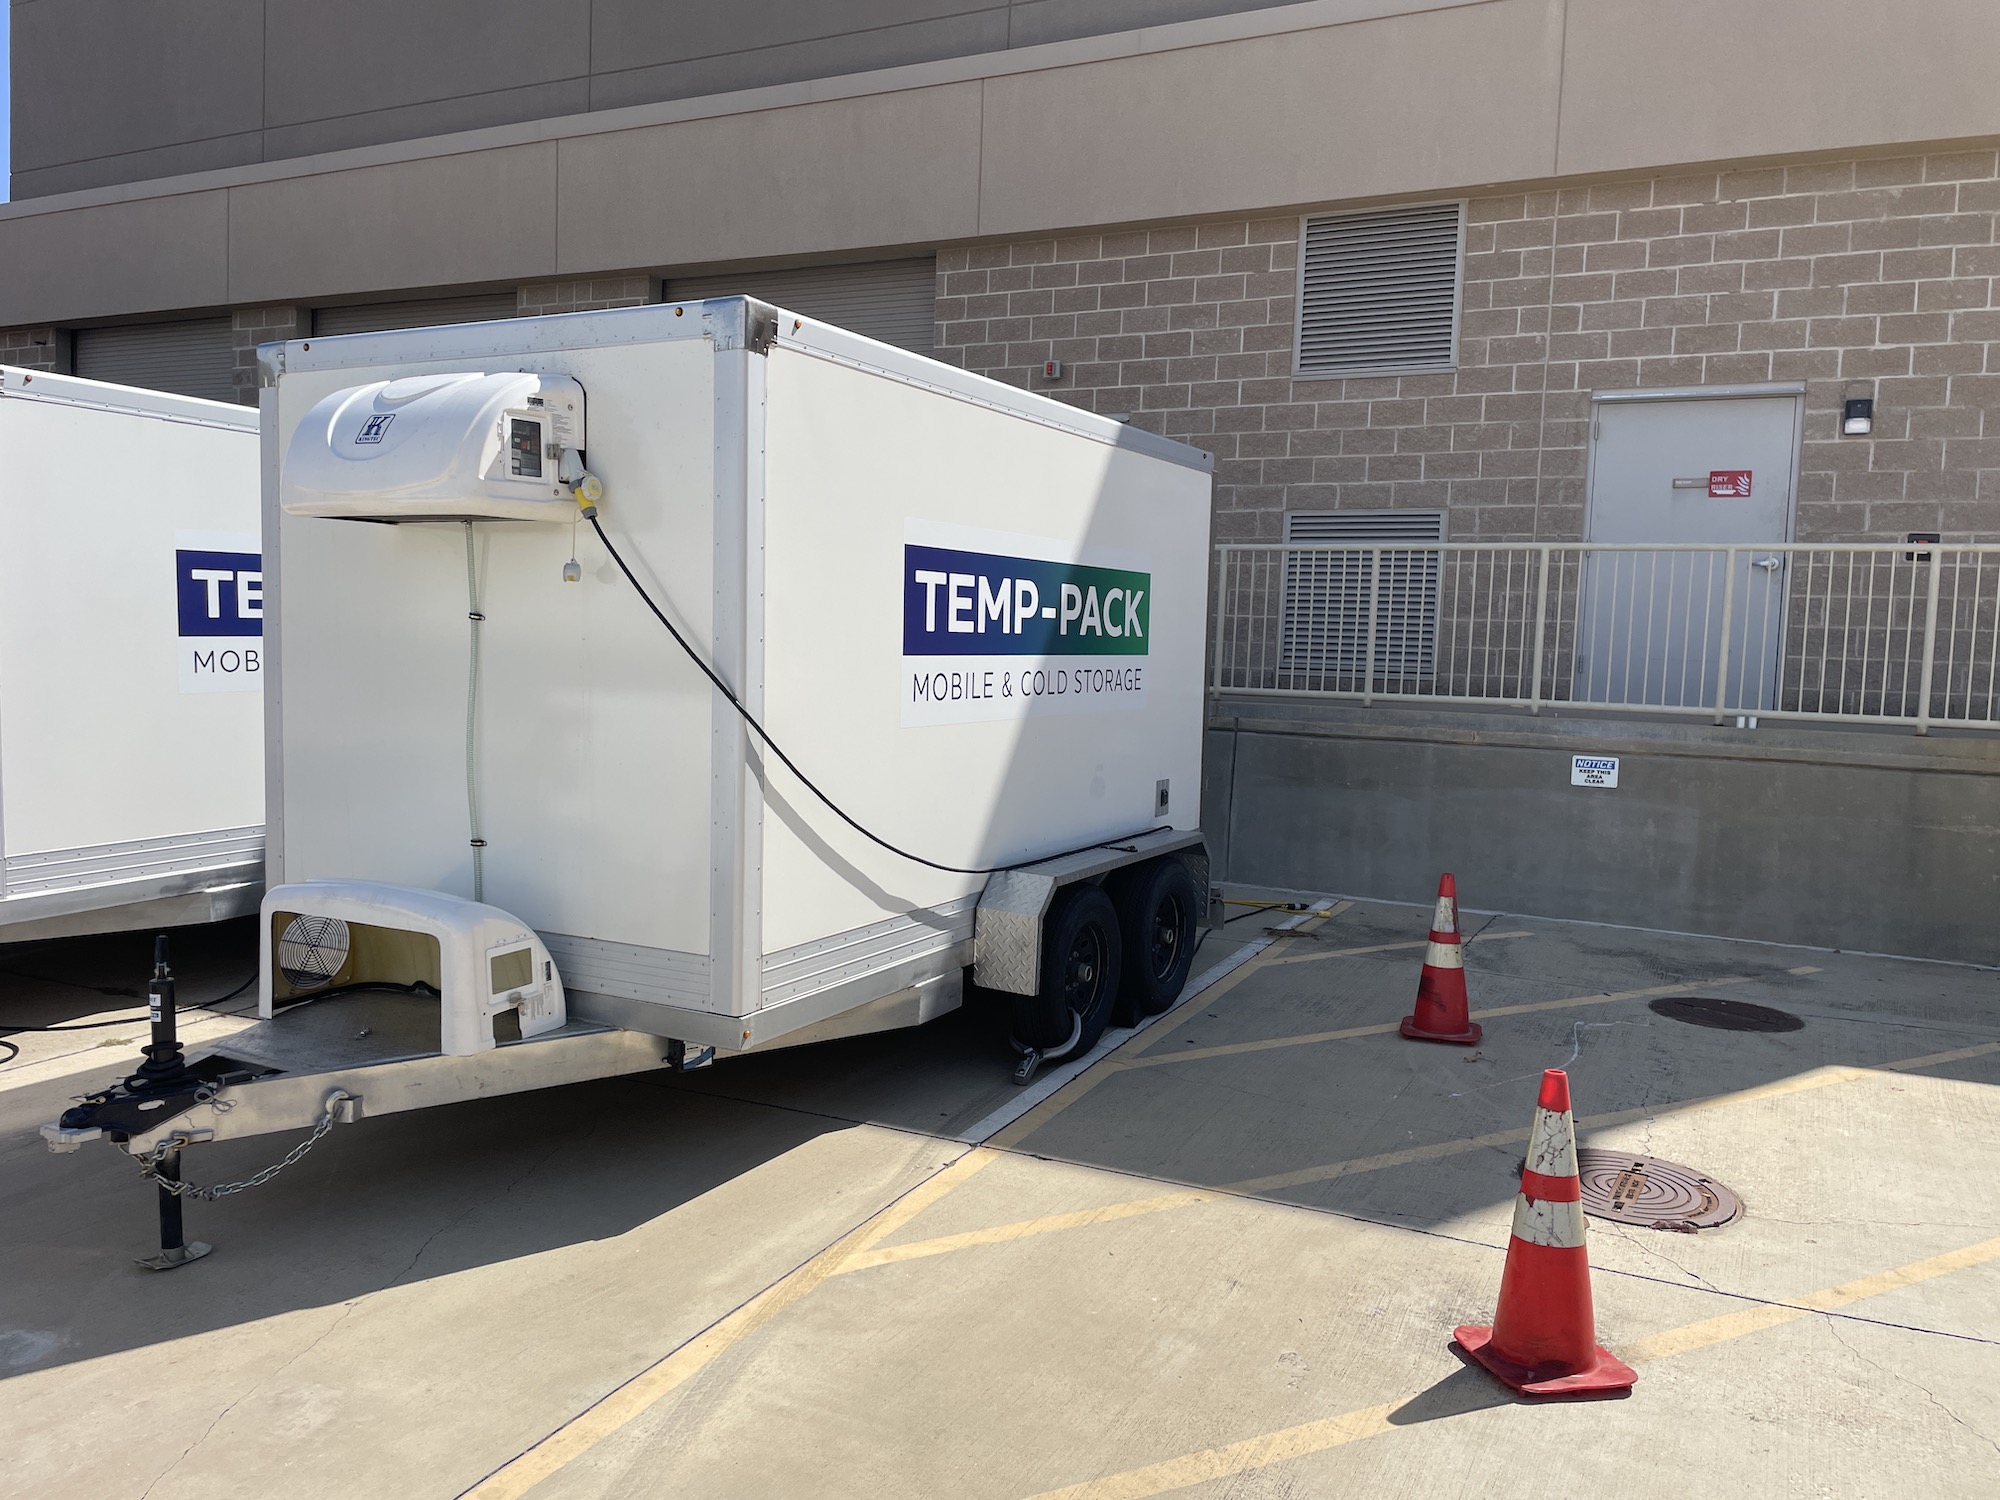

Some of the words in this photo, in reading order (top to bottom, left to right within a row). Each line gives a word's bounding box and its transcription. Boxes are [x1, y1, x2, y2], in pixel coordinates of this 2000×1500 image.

[915, 569, 1145, 638] TEMP-PACK
[913, 671, 994, 702] MOBILE
[1001, 672, 1013, 698] &
[1021, 669, 1068, 696] COLD
[1074, 668, 1142, 693] STORAGE
[1577, 760, 1614, 768] NOTICE
